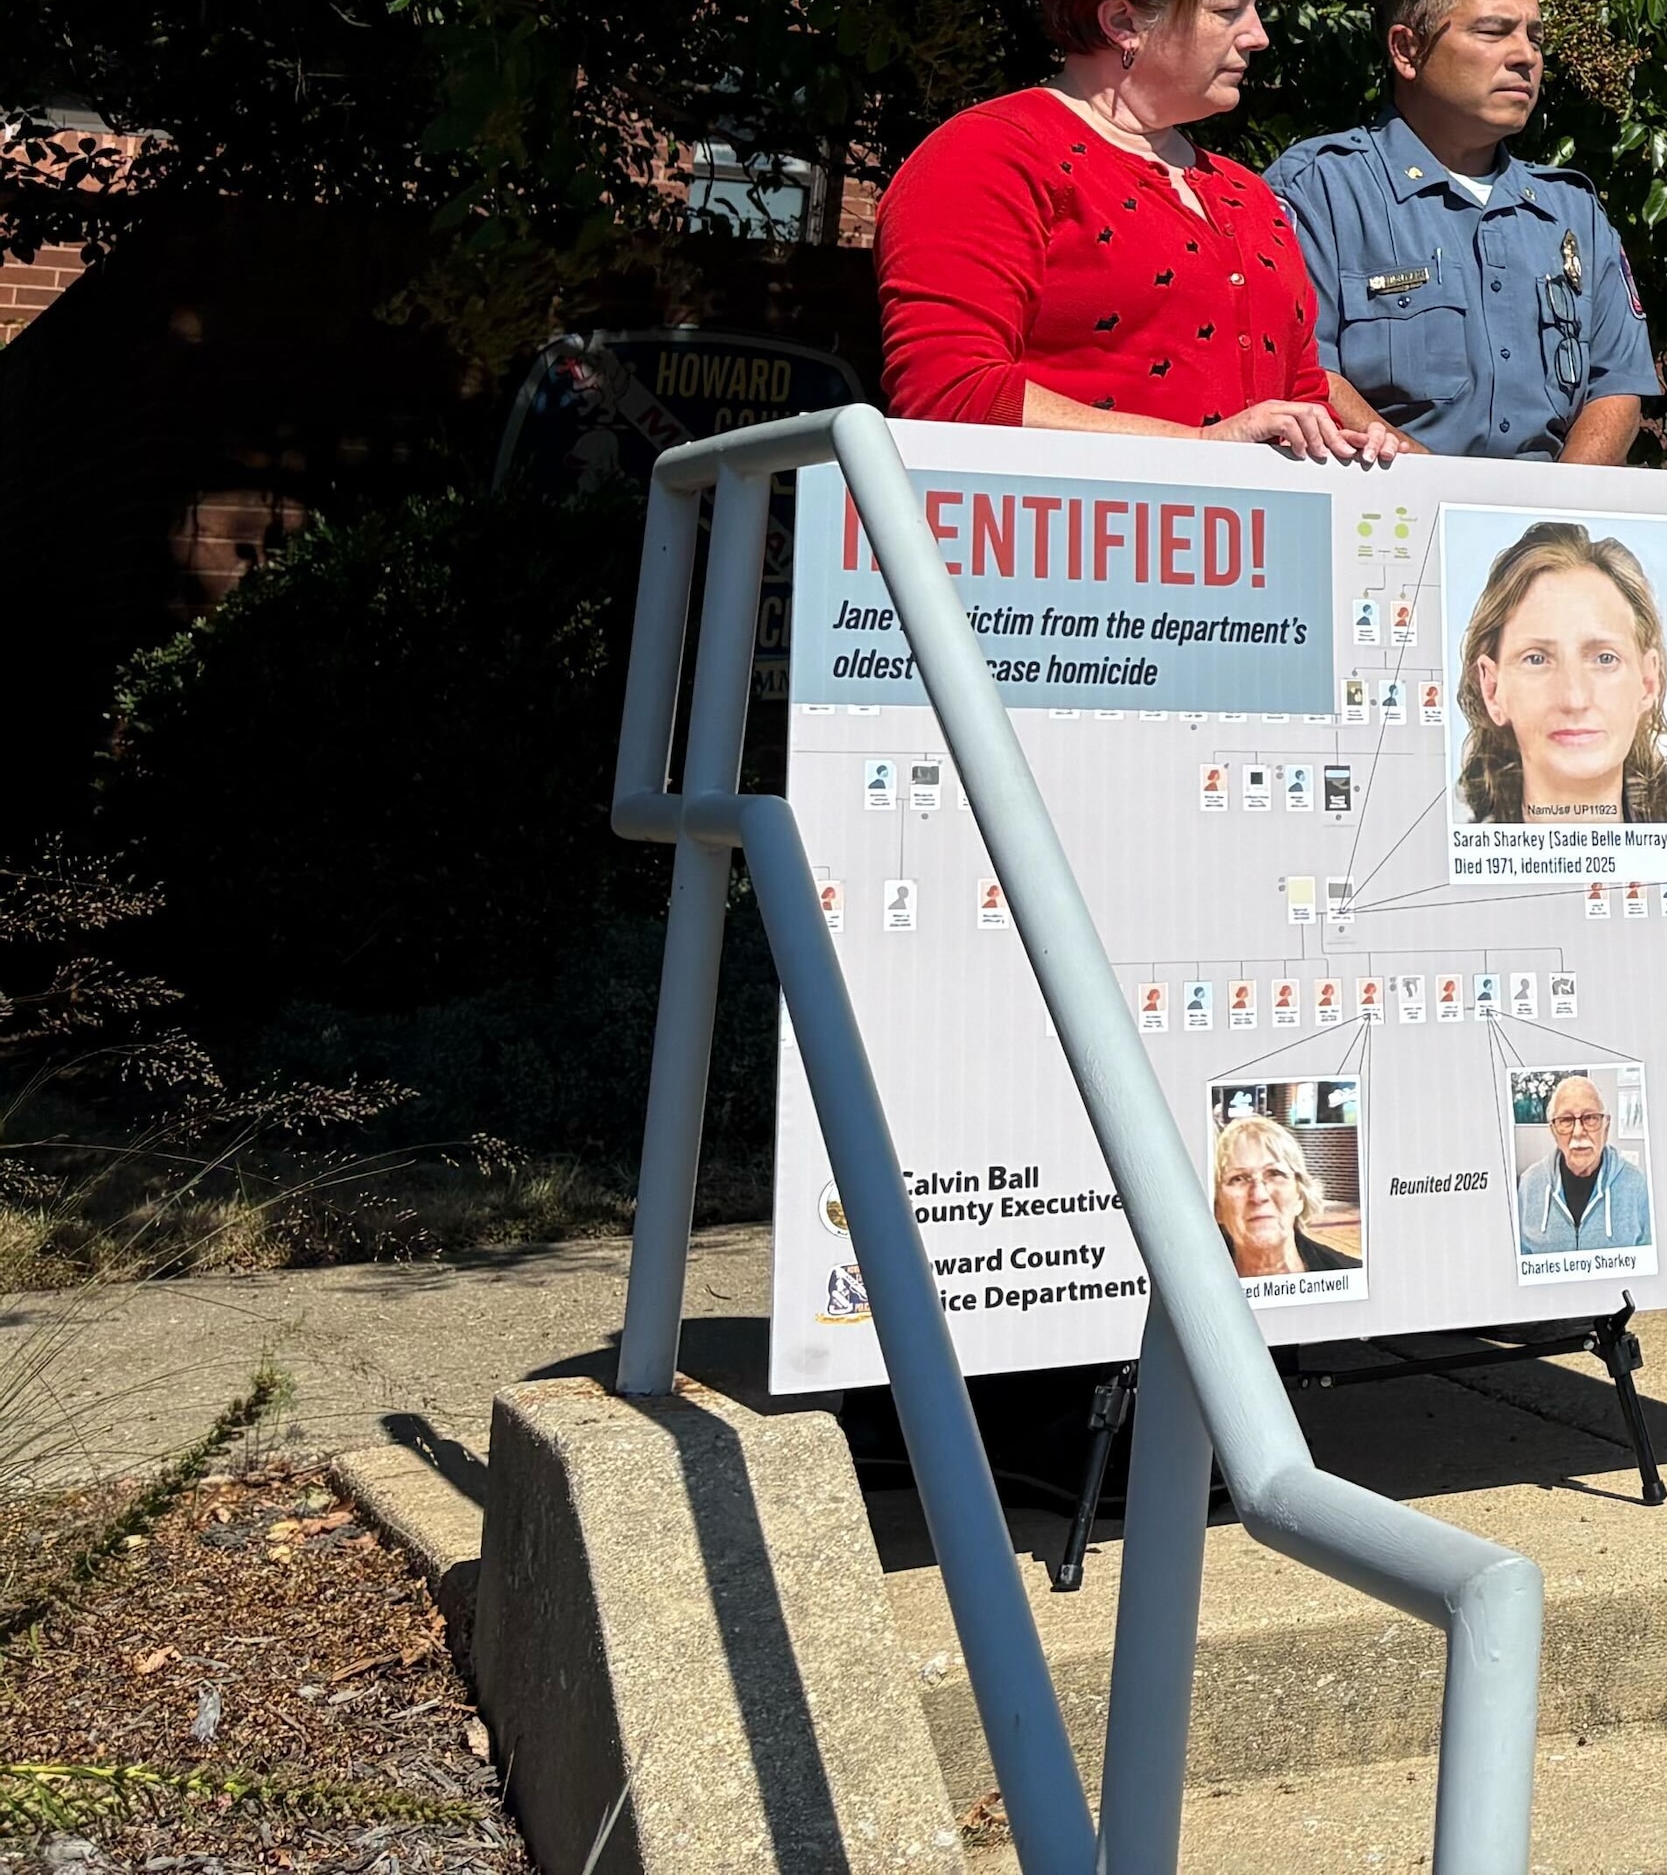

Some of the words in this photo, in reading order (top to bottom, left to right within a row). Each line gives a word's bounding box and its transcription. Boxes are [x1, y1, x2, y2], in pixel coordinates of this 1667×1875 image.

[656, 351, 792, 403] HOWARD
[843, 486, 1266, 588] IENTIFIED!
[832, 600, 894, 631] Jane
[1040, 607, 1100, 638] from
[1106, 610, 1146, 640] the
[1150, 612, 1308, 646] department's
[832, 648, 916, 680] oldest
[1046, 654, 1159, 685] homicide
[1527, 805, 1571, 815] NamUs#
[1453, 831, 1490, 847] Sarah
[1493, 831, 1545, 850] Sharkey
[1591, 830, 1622, 847] Belle
[1454, 858, 1482, 874] Died
[1486, 858, 1517, 876] 1971,
[1521, 857, 1582, 874] identified
[1585, 857, 1616, 873] 2025
[988, 1166, 1039, 1191] Ball
[1390, 1173, 1453, 1196] Reunited
[1455, 1172, 1489, 1192] 2025
[914, 1201, 994, 1226] ounty
[1000, 1190, 1125, 1218] Executive
[931, 1248, 1002, 1275] ward
[1010, 1245, 1106, 1269] County
[1520, 1260, 1561, 1276] Charles
[1563, 1258, 1592, 1274] Leroy
[1594, 1255, 1637, 1271] Sharkey
[940, 1290, 977, 1312] ice
[984, 1276, 1148, 1312] Department
[1263, 1280, 1296, 1297] Marie
[1299, 1274, 1349, 1294] Cantwell
